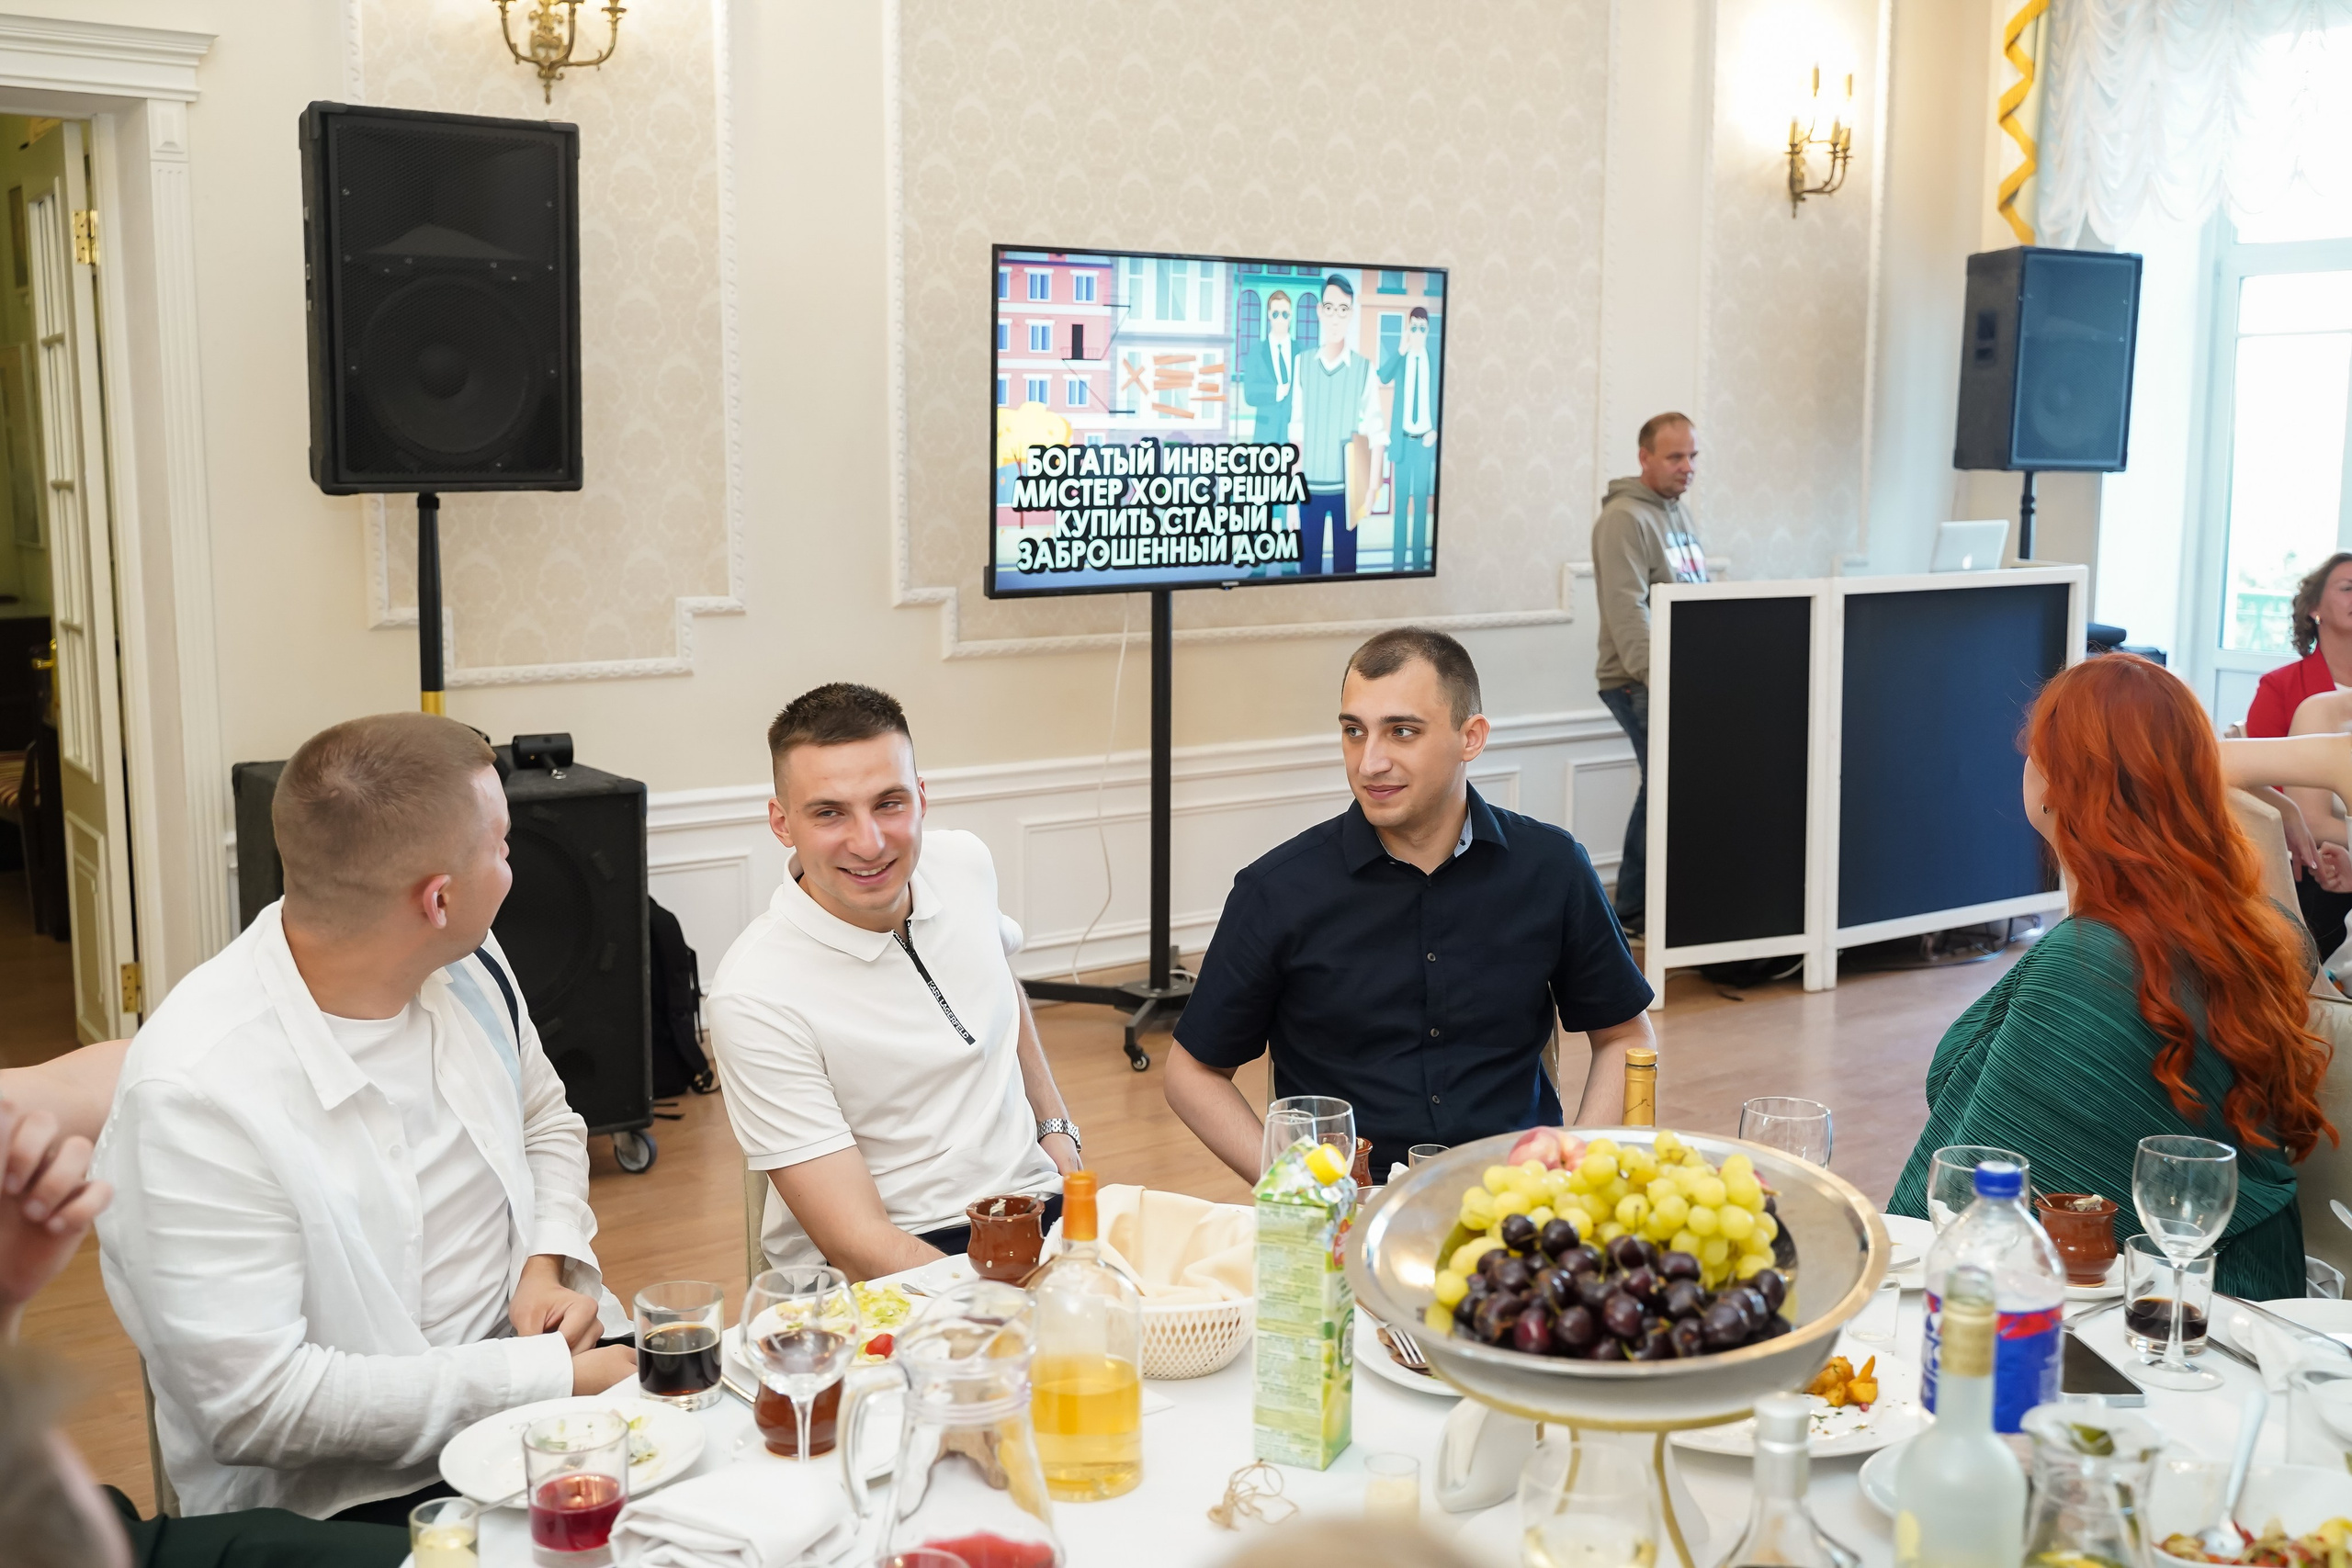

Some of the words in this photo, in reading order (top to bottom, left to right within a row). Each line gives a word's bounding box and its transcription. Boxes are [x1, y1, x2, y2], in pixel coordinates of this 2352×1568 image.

[1026, 440, 1155, 477] БОГАТЫЙ
[1163, 446, 1295, 475] ИНВЕСТОР
[1012, 478, 1123, 508] МИСТЕР
[1129, 477, 1211, 505] ХОПС
[1218, 475, 1306, 503] РЕШИЛ
[1056, 508, 1156, 537] КУПИТЬ
[1162, 501, 1267, 535] СТАРЫЙ
[1016, 530, 1227, 570] ЗАБРОШЕННЫЙ
[1233, 533, 1298, 564] ДОМ
[928, 980, 942, 1001] KARL
[939, 999, 969, 1039] LAGERFELD
